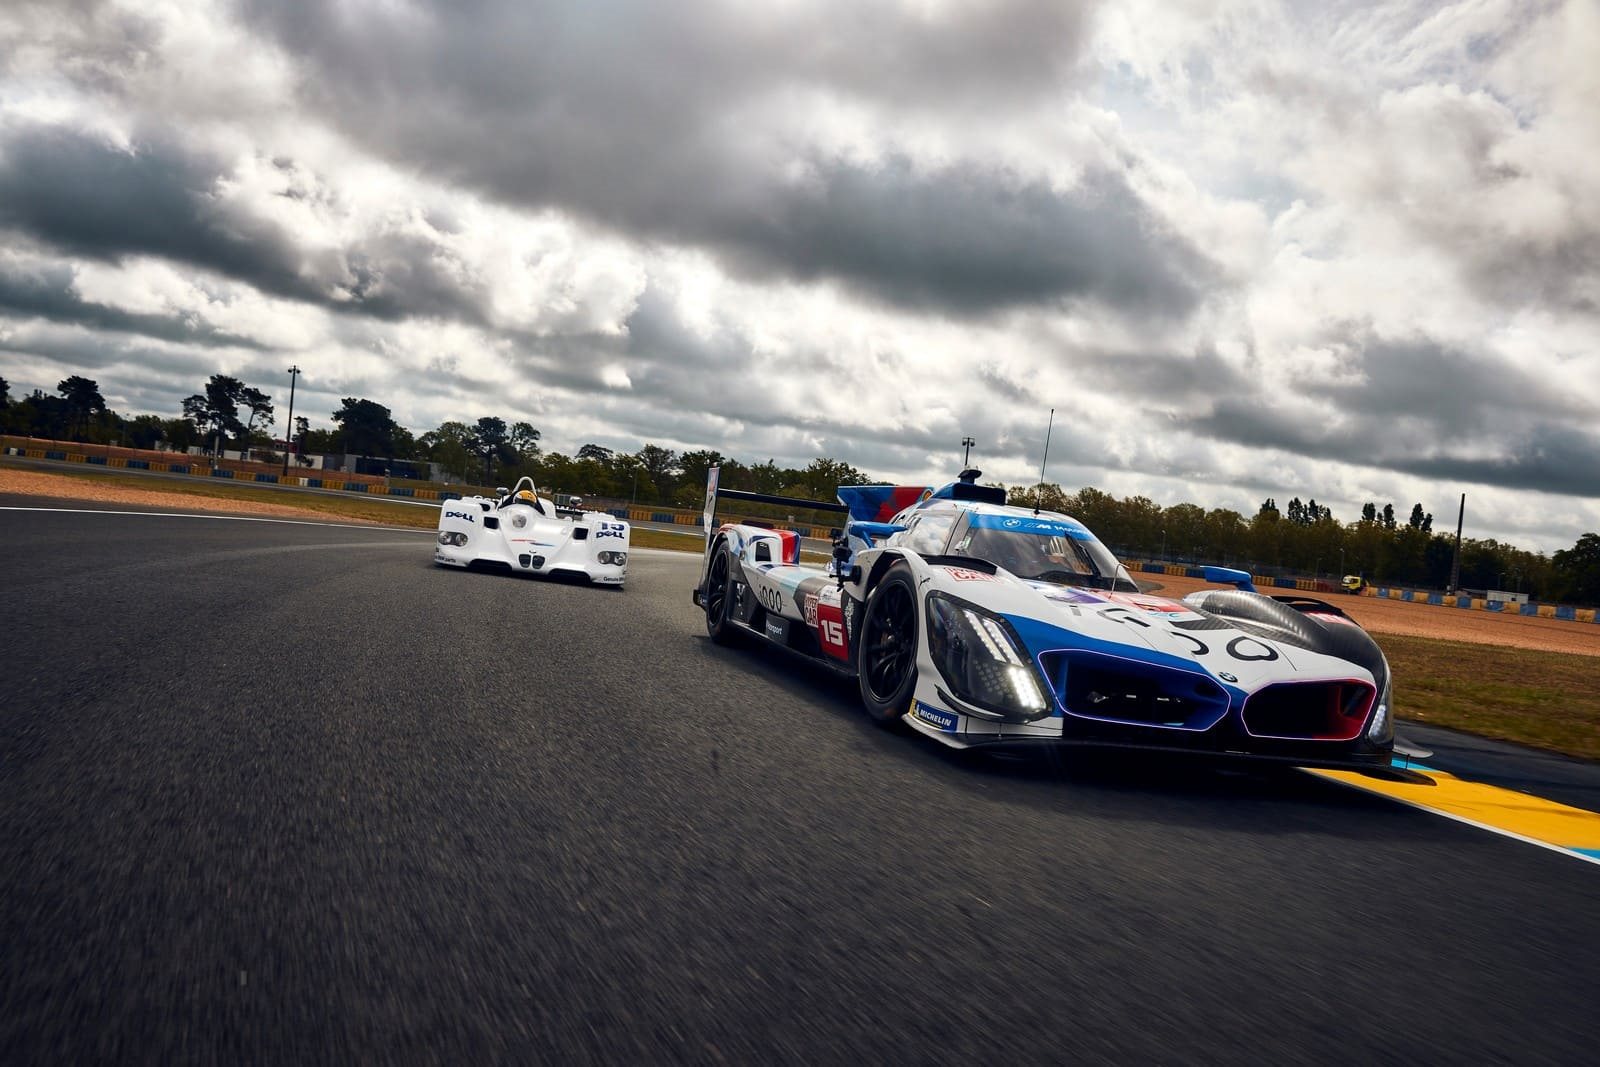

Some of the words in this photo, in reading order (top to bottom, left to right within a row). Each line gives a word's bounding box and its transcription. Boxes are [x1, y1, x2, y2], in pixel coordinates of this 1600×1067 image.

[445, 511, 475, 523] DELL
[596, 530, 625, 539] DELL
[821, 619, 843, 646] 15
[920, 709, 952, 726] MICHELIN
